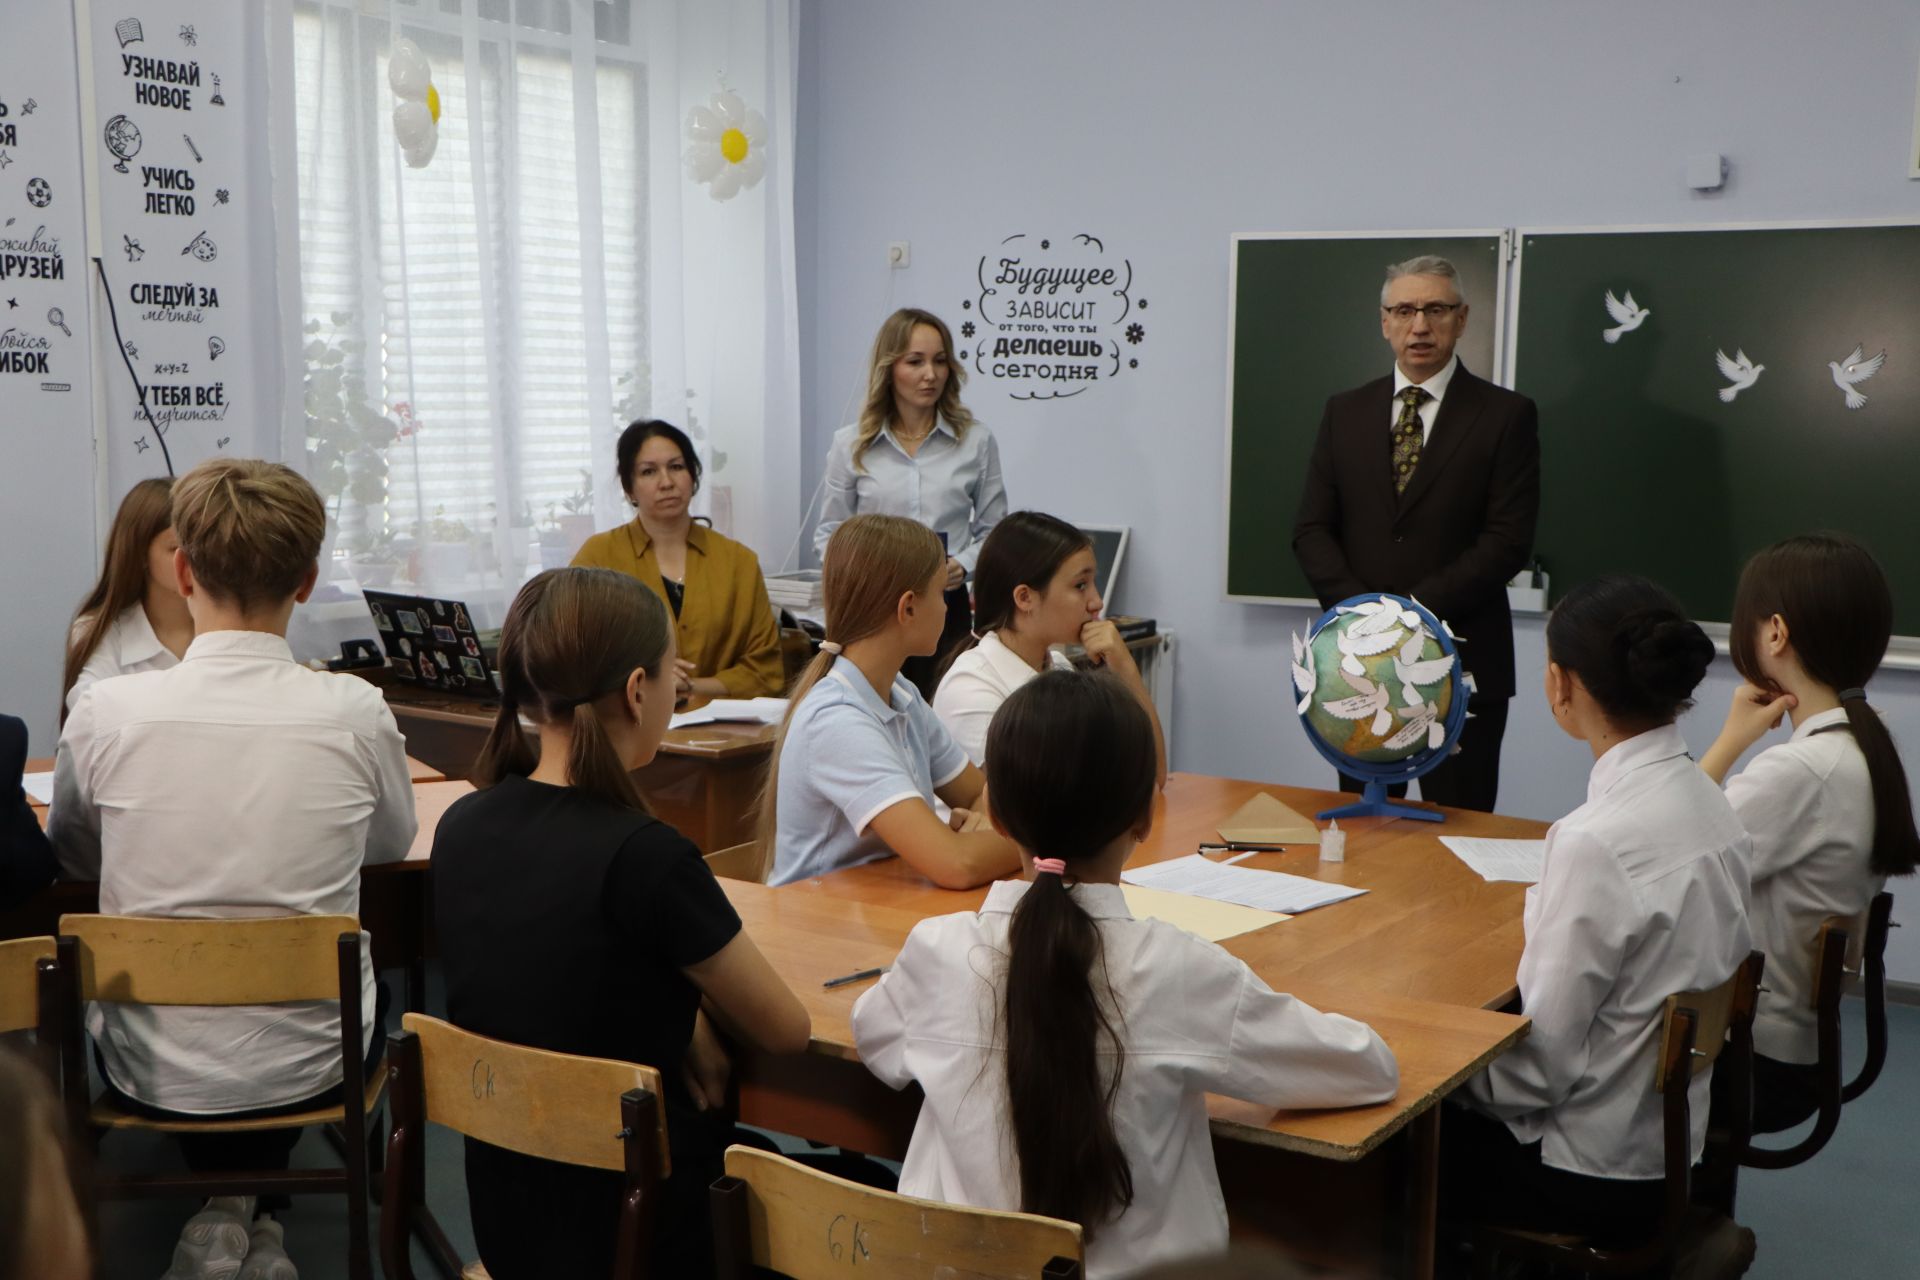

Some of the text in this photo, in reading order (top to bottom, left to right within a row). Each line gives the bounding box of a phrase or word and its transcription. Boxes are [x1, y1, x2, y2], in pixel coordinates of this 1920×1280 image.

[122, 53, 200, 87] УЗНАВАЙ
[135, 82, 192, 111] НОВОЕ
[141, 166, 195, 191] УЧИСЬ
[145, 192, 195, 216] ЛЕГКО
[995, 257, 1117, 295] Будущее
[130, 282, 219, 310] СЛЕДУЙ ЗА
[142, 307, 205, 324] мечтой
[1006, 299, 1096, 320] ЗАВИСИТ
[999, 324, 1097, 334] от того, что ты
[993, 337, 1103, 358] делаешь
[992, 362, 1099, 382] сегодня
[151, 386, 191, 406] ТЕБЯ
[196, 382, 224, 406] ВСЁ
